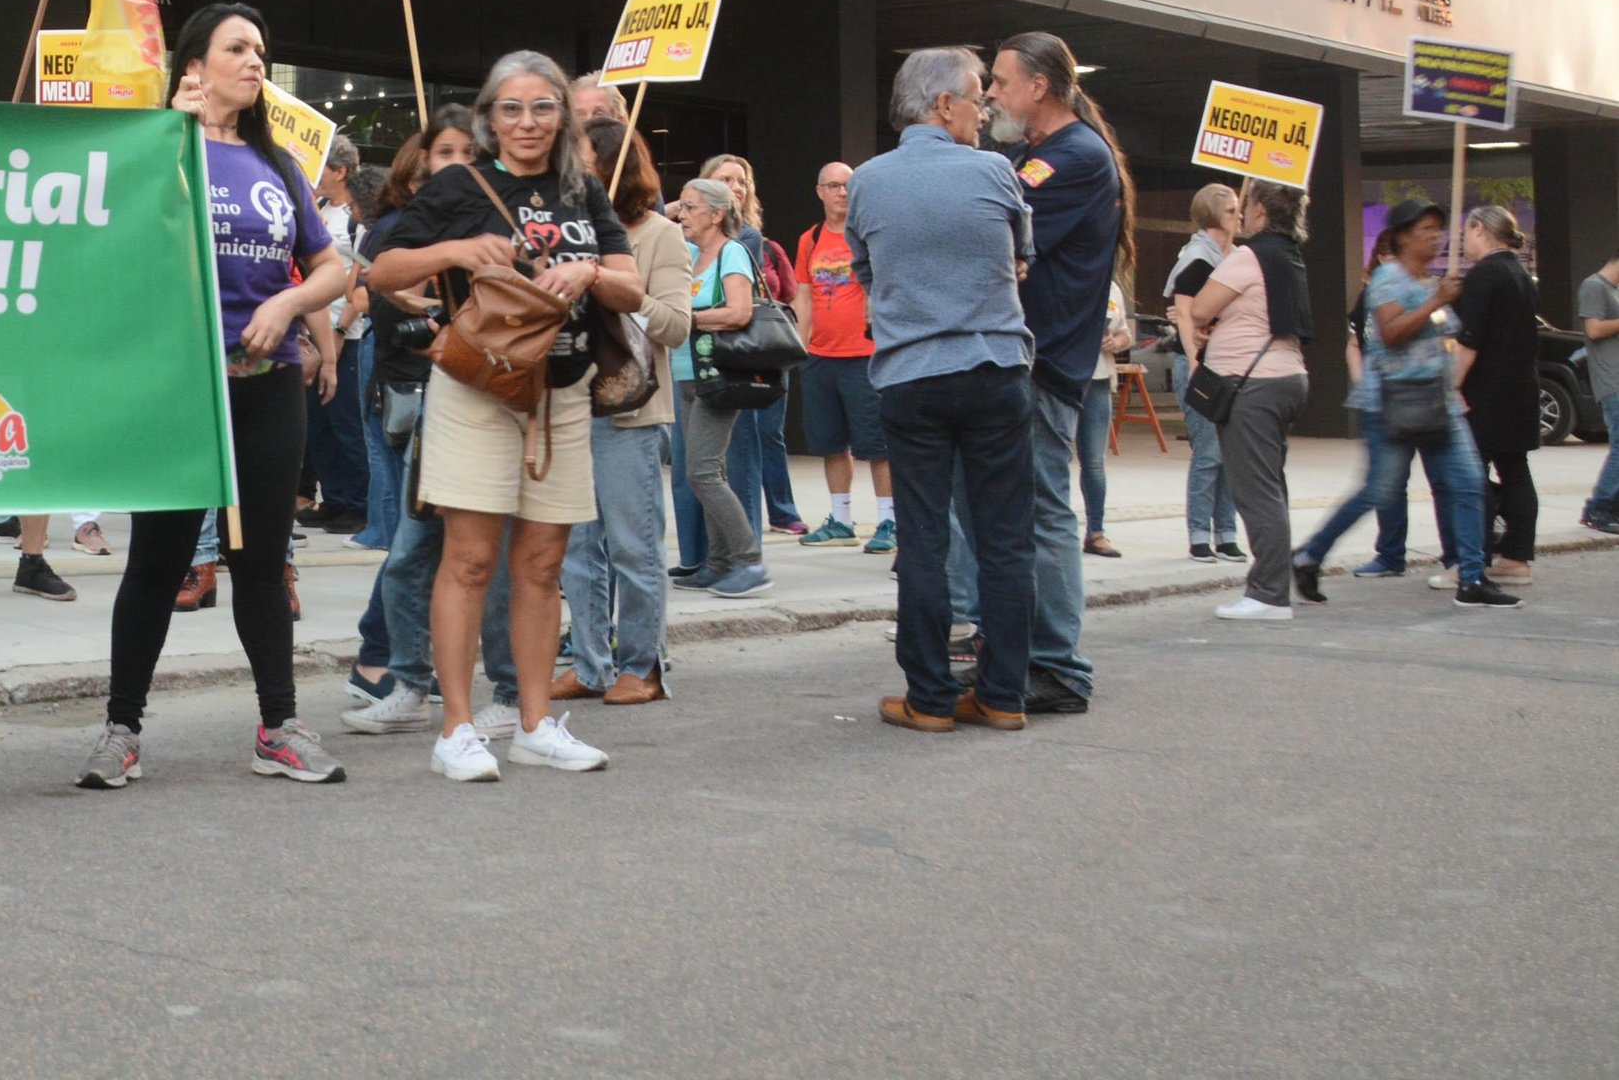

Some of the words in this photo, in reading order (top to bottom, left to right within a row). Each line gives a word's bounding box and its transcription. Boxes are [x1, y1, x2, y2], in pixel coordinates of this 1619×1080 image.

[618, 3, 683, 37] NEGOCIA
[43, 54, 79, 76] NEG
[608, 37, 653, 70] MELO!
[42, 80, 91, 102] MELO!
[107, 86, 134, 98] Simpa
[1208, 106, 1278, 141] NEGOCIA
[1283, 120, 1311, 151] JÁ,
[1201, 132, 1252, 162] MELO!
[518, 206, 554, 224] Por
